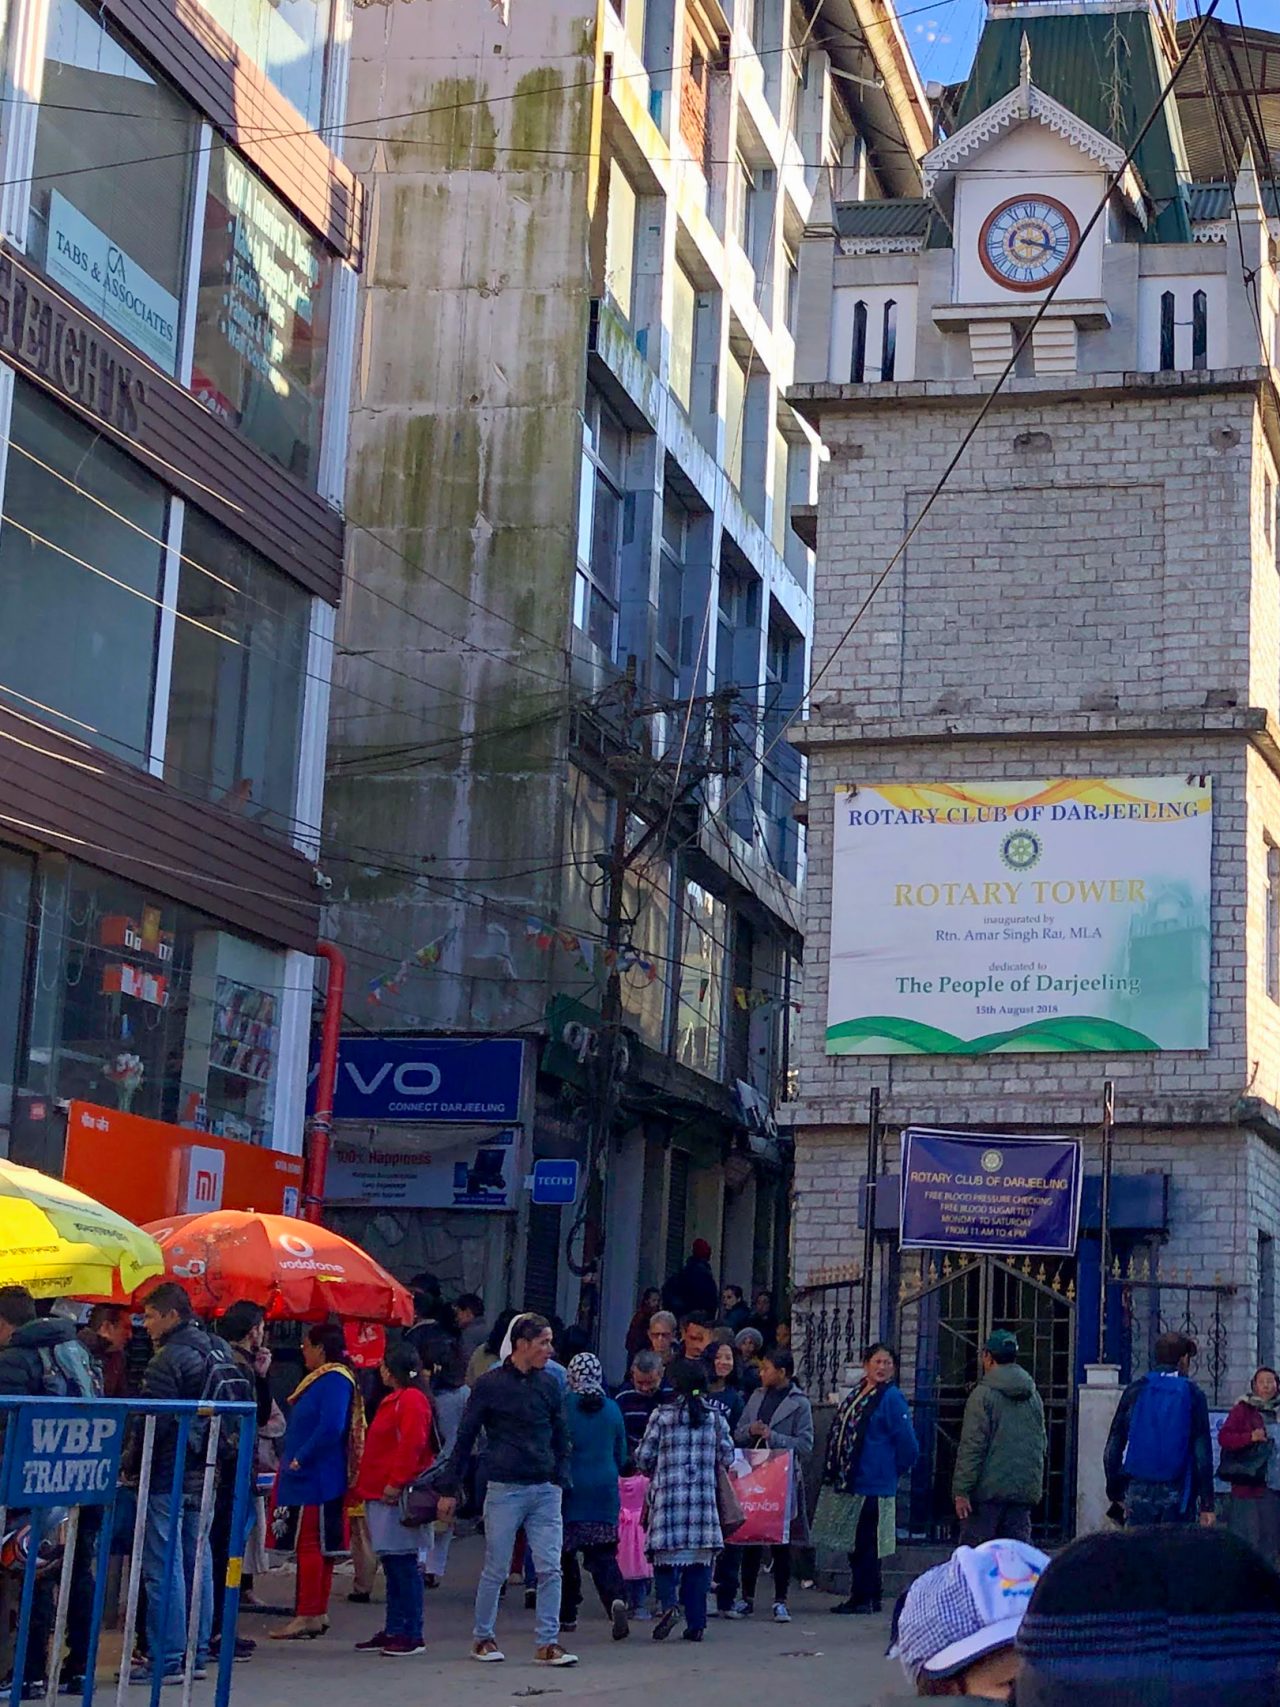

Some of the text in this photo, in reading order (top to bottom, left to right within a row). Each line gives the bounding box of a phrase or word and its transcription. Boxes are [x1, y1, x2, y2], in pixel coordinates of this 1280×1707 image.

[56, 231, 89, 272] TABS
[90, 262, 102, 283] &
[103, 273, 174, 343] ASSOCIATES
[848, 801, 1199, 827] ROTARY CLUB OF DARJEELING
[893, 878, 1147, 908] ROTARY TOWER
[983, 913, 1055, 927] inaugurated by
[936, 929, 961, 942] Rtn.
[964, 929, 1000, 941] Amar
[1003, 927, 1039, 943] Singh
[1070, 926, 1102, 940] MLA
[988, 961, 1047, 972] dedicated to
[895, 973, 1141, 998] The People of Darjeeling
[976, 1004, 1059, 1017] 15th August 2018
[388, 1102, 506, 1113] CONNECT DARJEELING
[910, 1171, 1068, 1190] ROTARY CLUB OF DARJEELING
[944, 1192, 972, 1202] BLOOD
[959, 1204, 987, 1214] BLOOD
[941, 1214, 976, 1224] MONDAY
[979, 1216, 991, 1225] TO
[996, 1228, 1007, 1238] TO
[278, 1259, 346, 1275] vodafone
[31, 1418, 118, 1454] WBP
[22, 1458, 112, 1494] TRAFFIC
